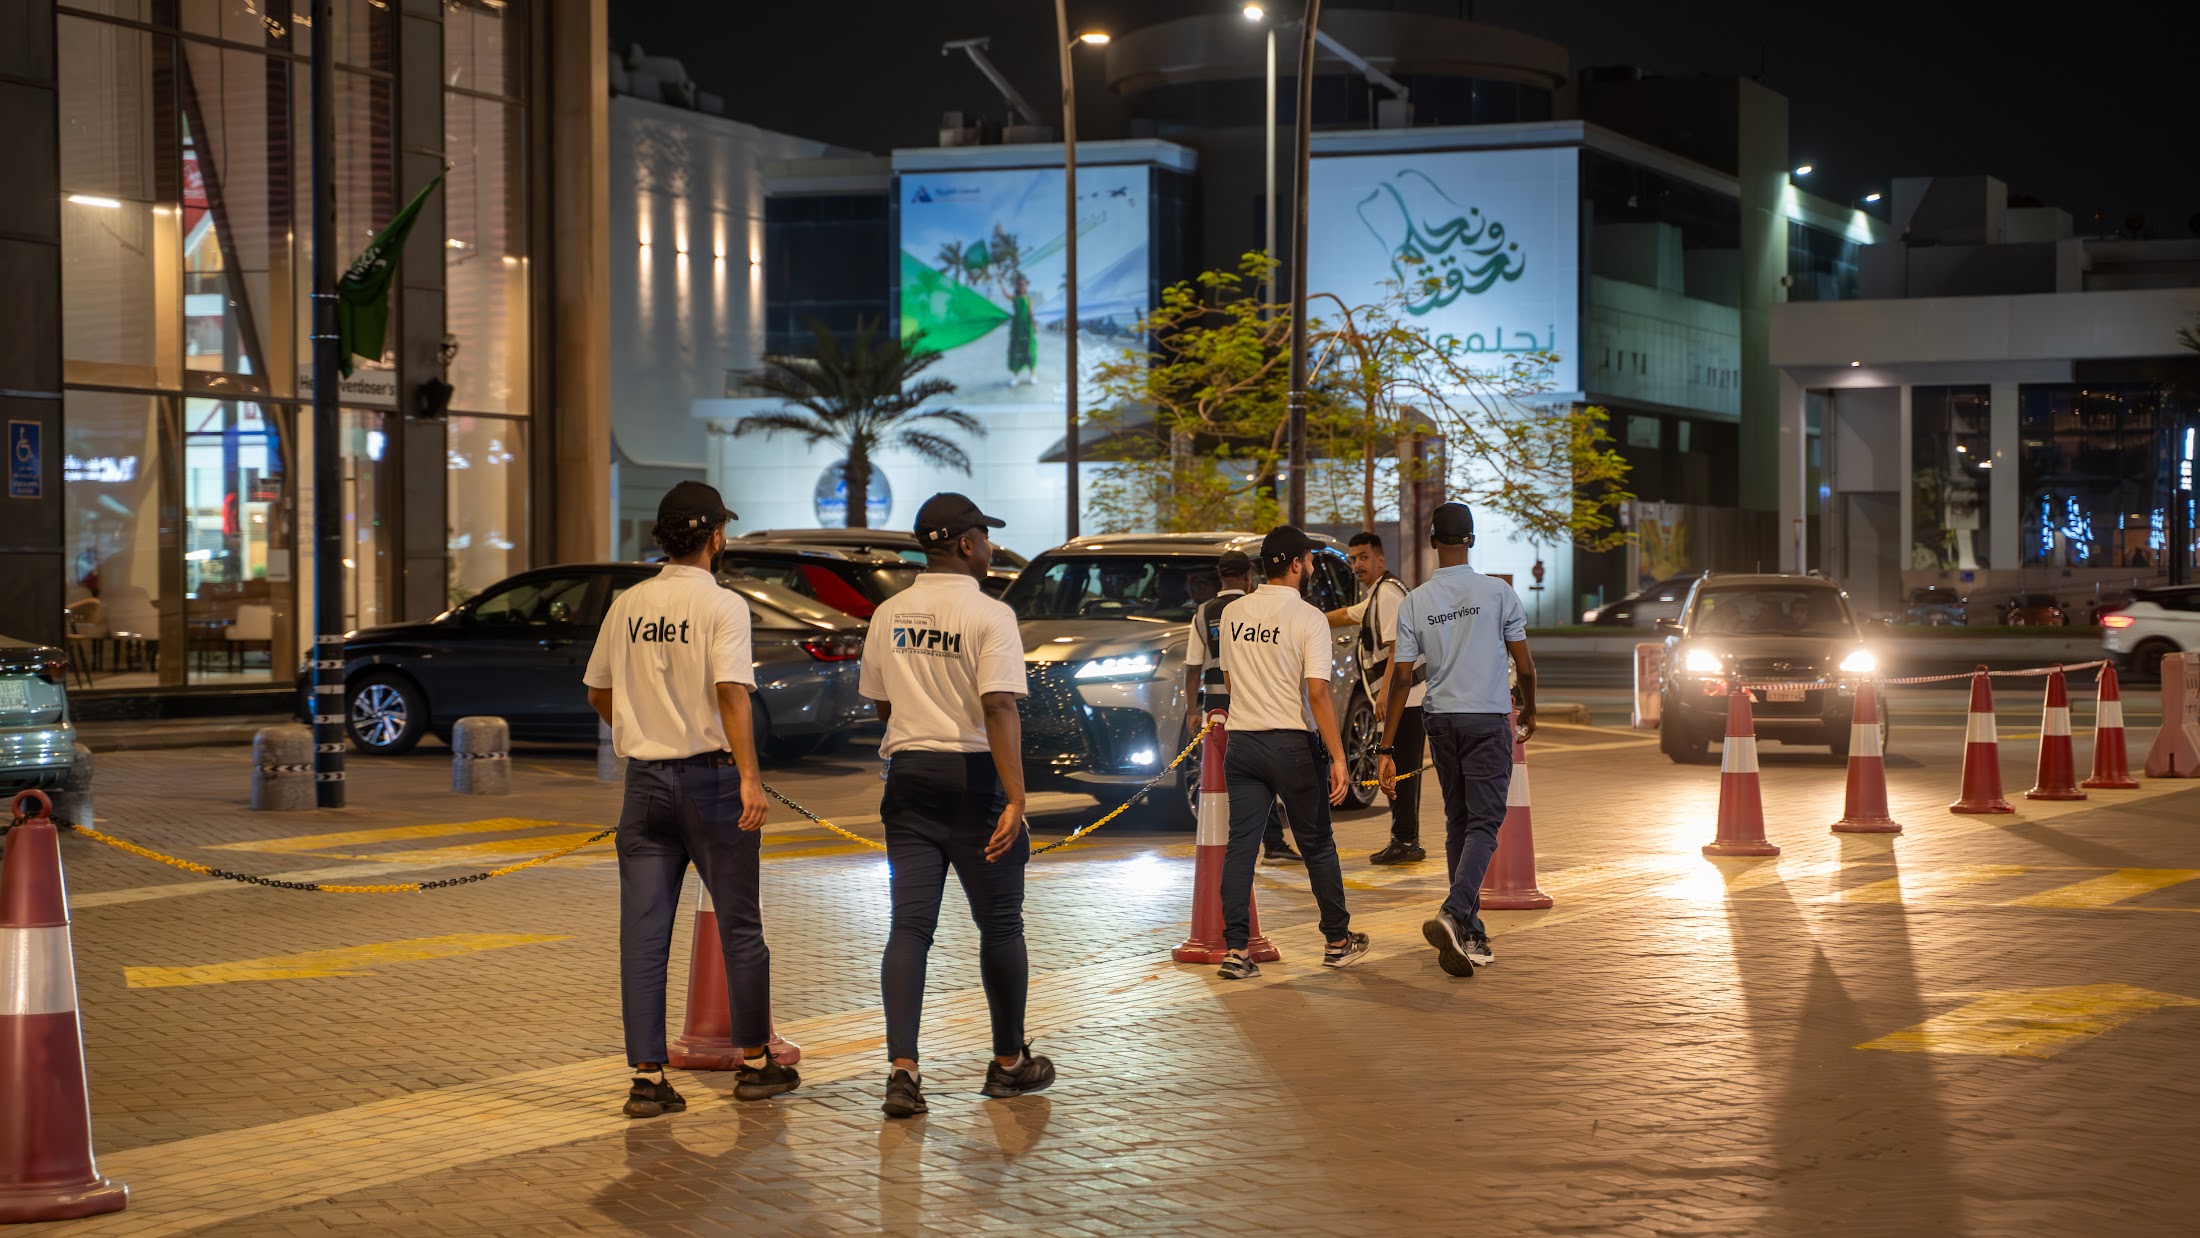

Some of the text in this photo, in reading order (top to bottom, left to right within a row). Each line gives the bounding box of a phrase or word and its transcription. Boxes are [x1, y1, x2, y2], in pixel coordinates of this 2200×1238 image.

[1464, 324, 1556, 355] نحلم
[340, 380, 396, 396] verdoser's
[1427, 606, 1481, 626] Supervisor
[628, 616, 690, 644] Valet
[907, 627, 961, 653] VPM
[1231, 621, 1280, 645] Valet
